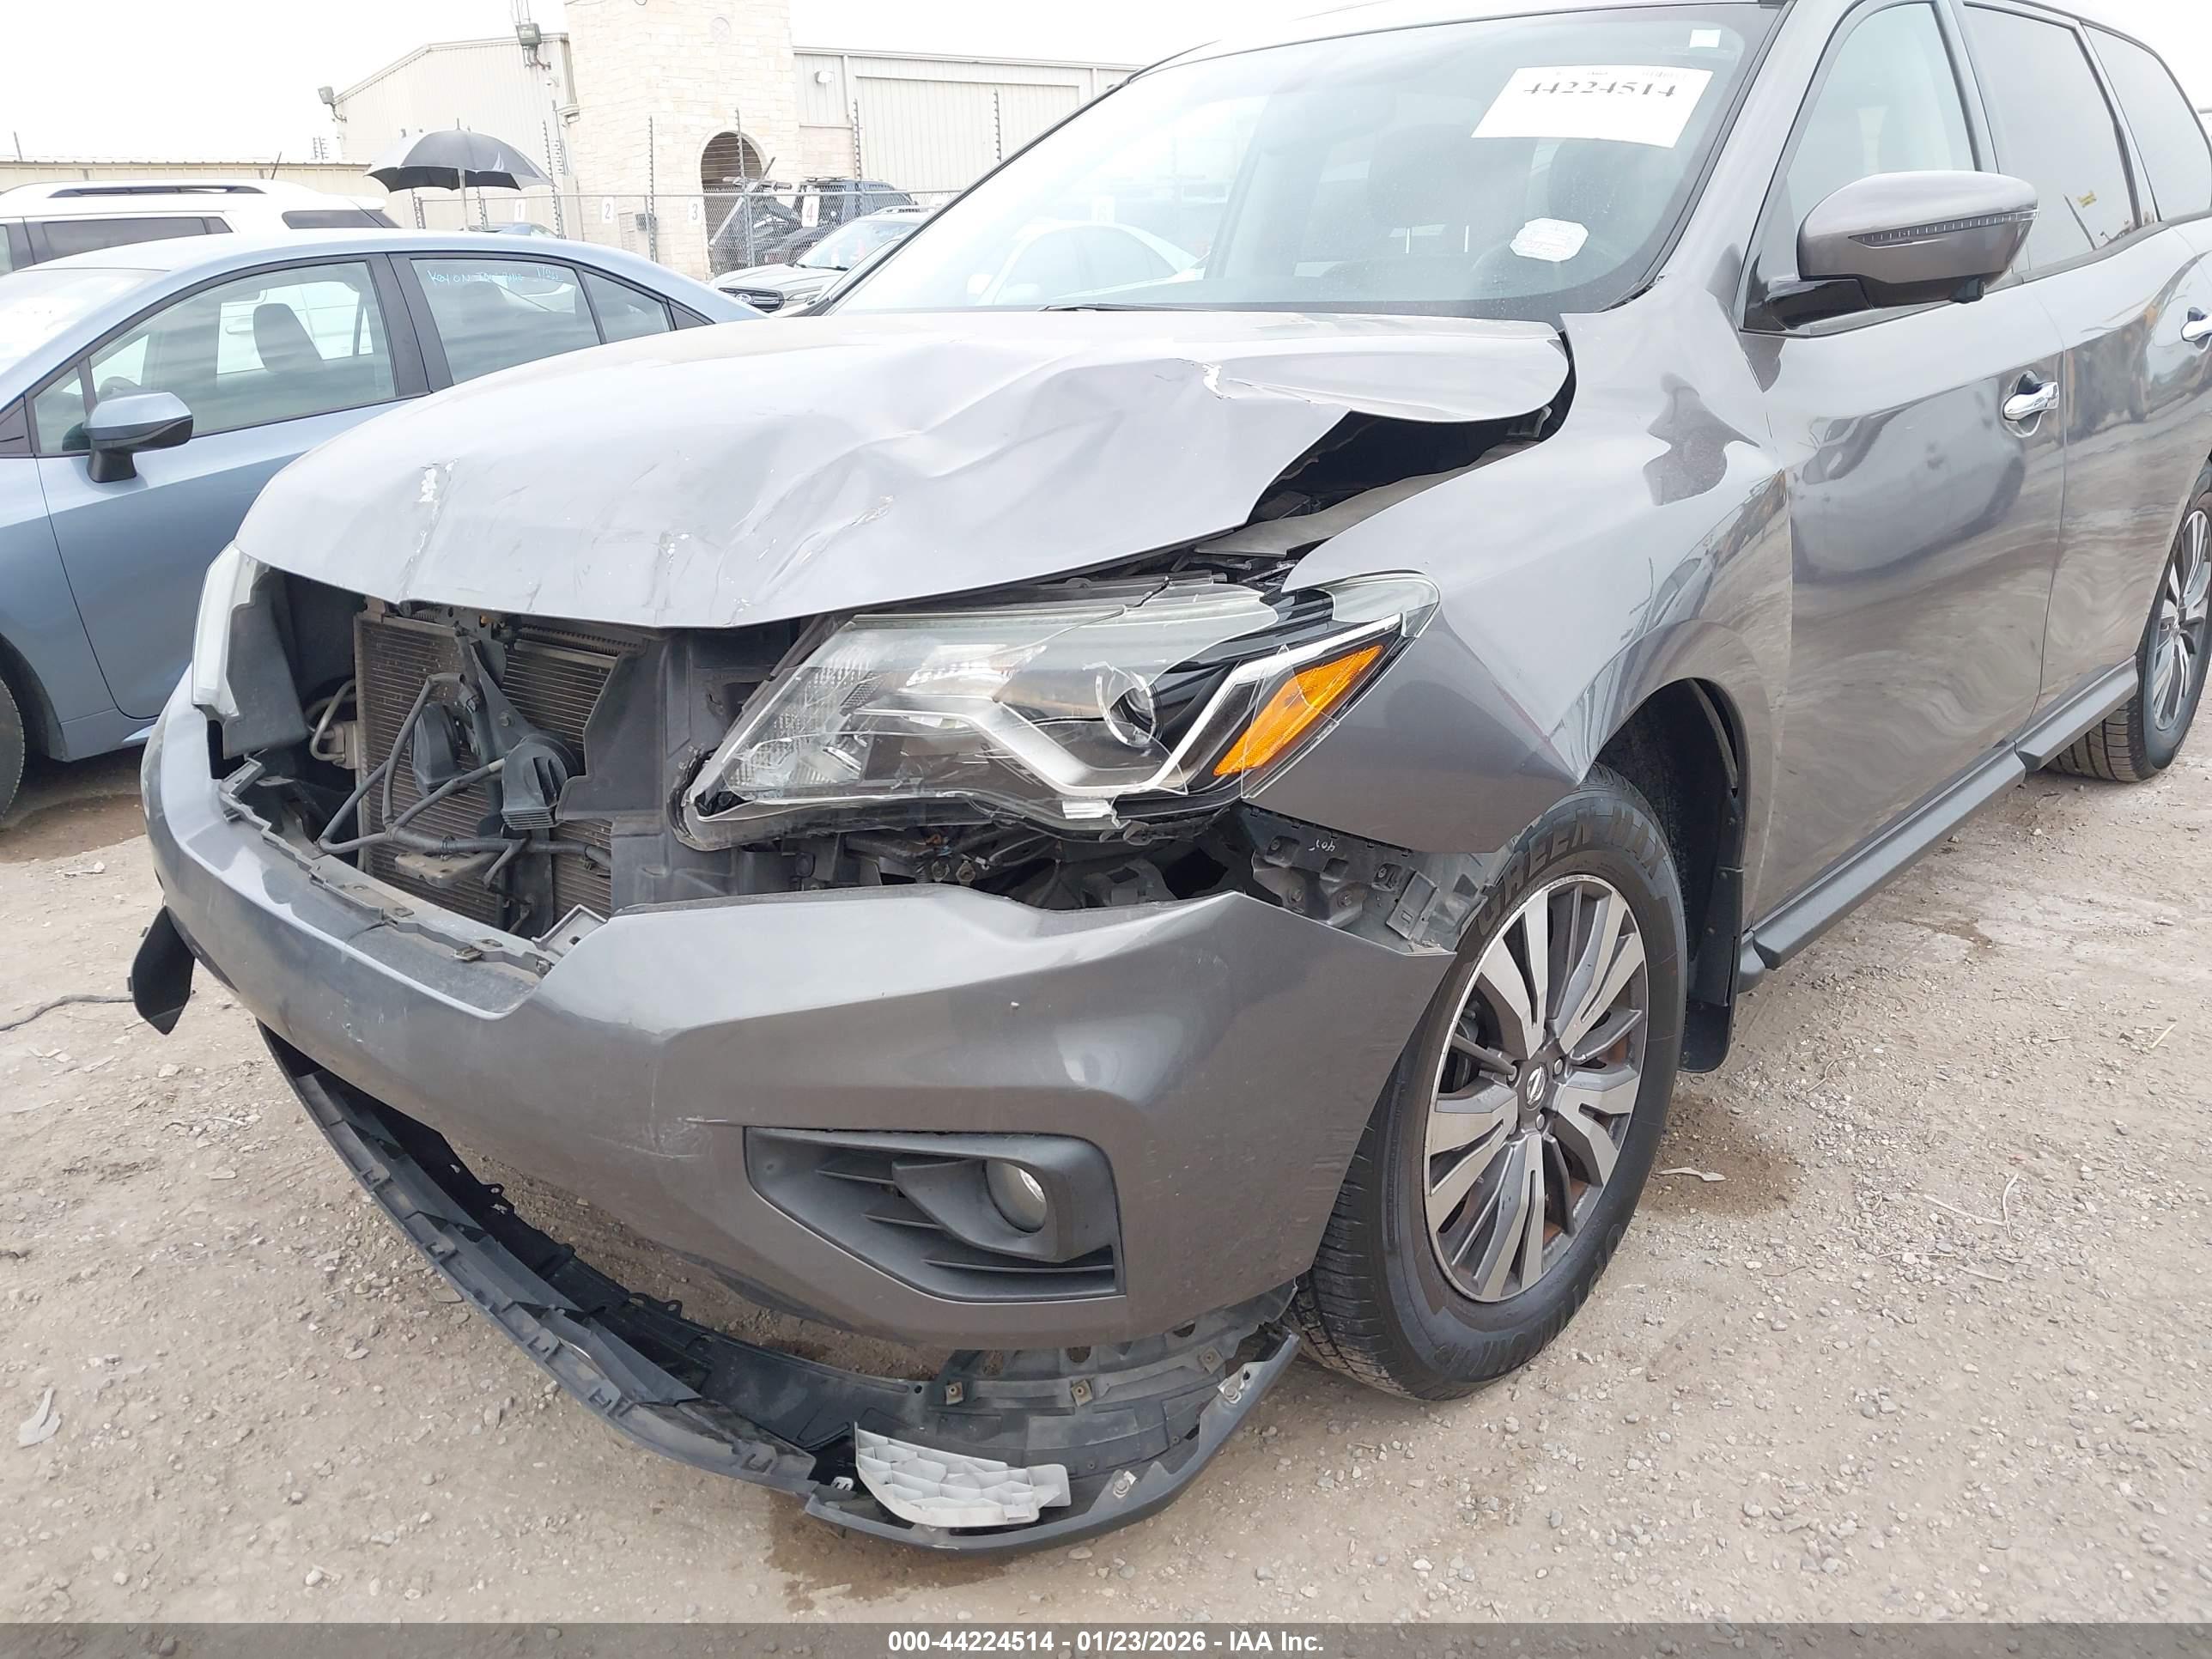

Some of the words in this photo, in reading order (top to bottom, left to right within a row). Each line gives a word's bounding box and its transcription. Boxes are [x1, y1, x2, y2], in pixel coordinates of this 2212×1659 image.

[1523, 81, 1676, 98] 44224514
[605, 203, 611, 219] 2
[691, 204, 698, 220] 3
[805, 204, 814, 222] 4
[1474, 808, 1595, 936] GREEN
[1606, 805, 1667, 883] MAX
